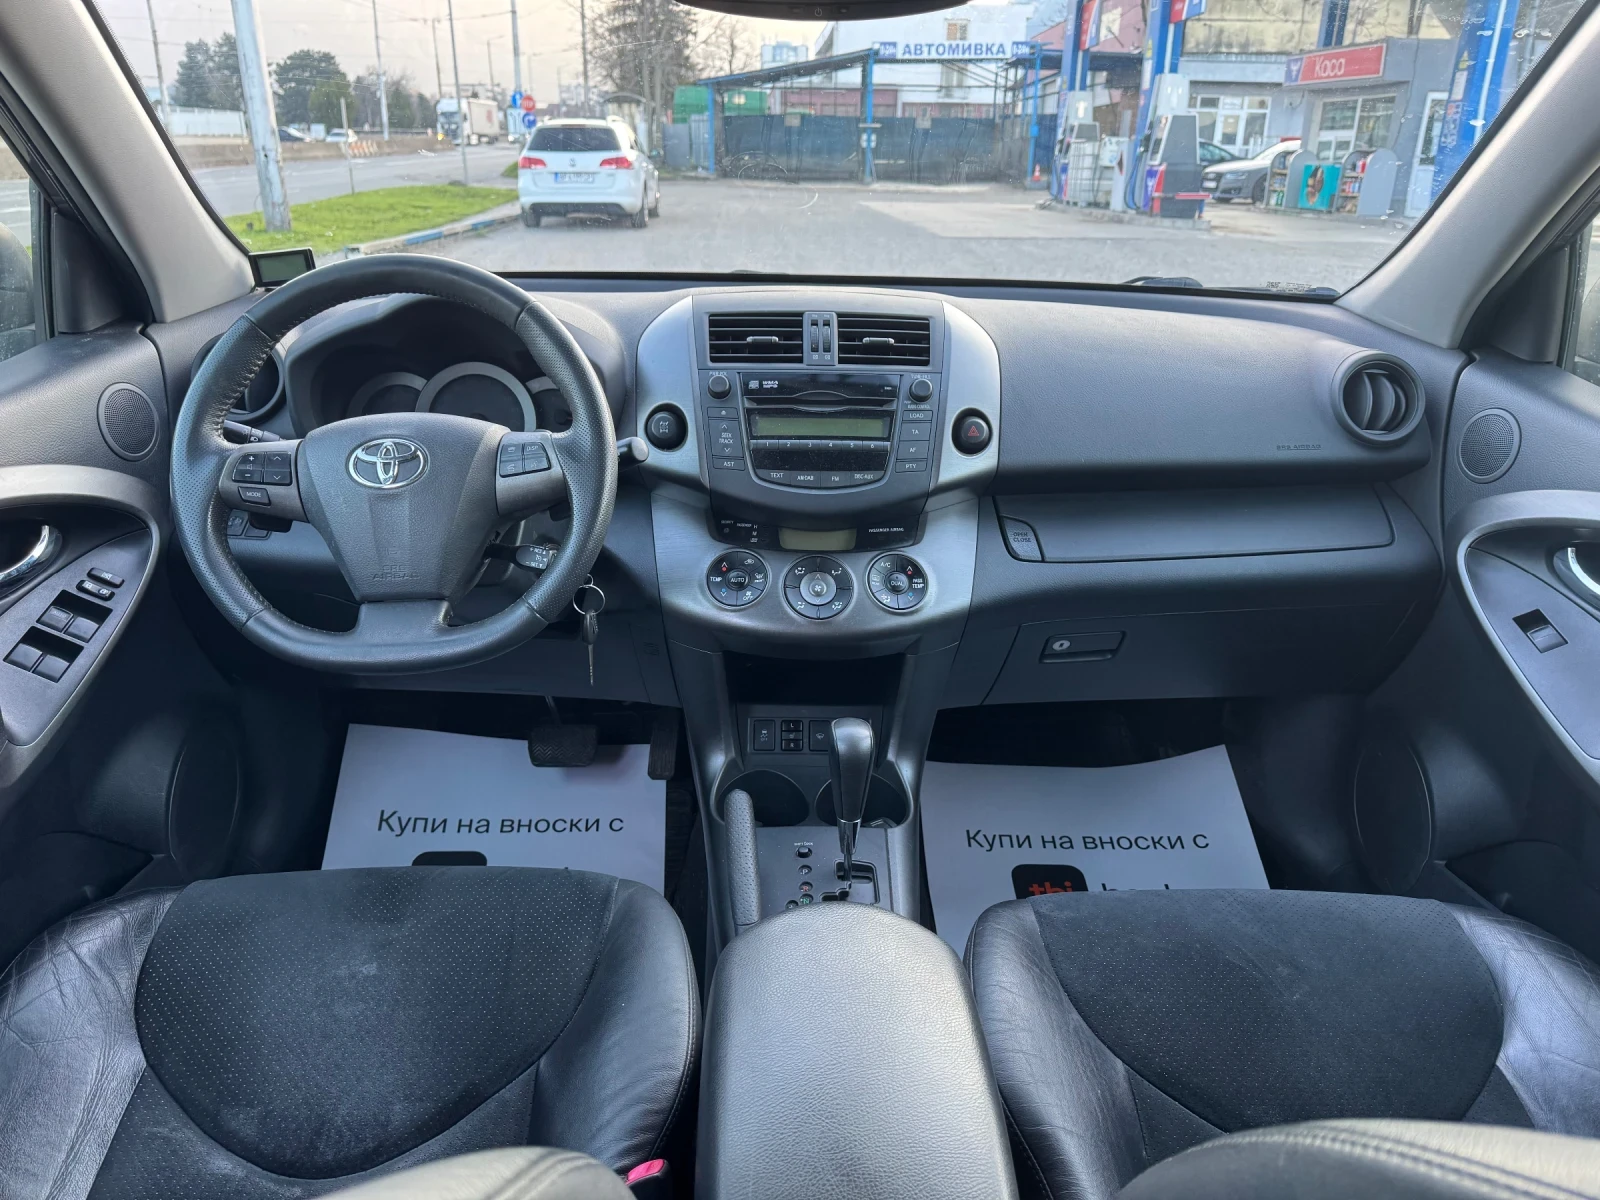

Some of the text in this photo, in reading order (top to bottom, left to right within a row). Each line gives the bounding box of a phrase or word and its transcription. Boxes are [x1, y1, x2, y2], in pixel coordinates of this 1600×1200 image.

[902, 43, 1006, 56] АВТОМИВКА
[377, 809, 624, 837] Купи на вноски с
[966, 829, 1209, 852] Купи на вноски с
